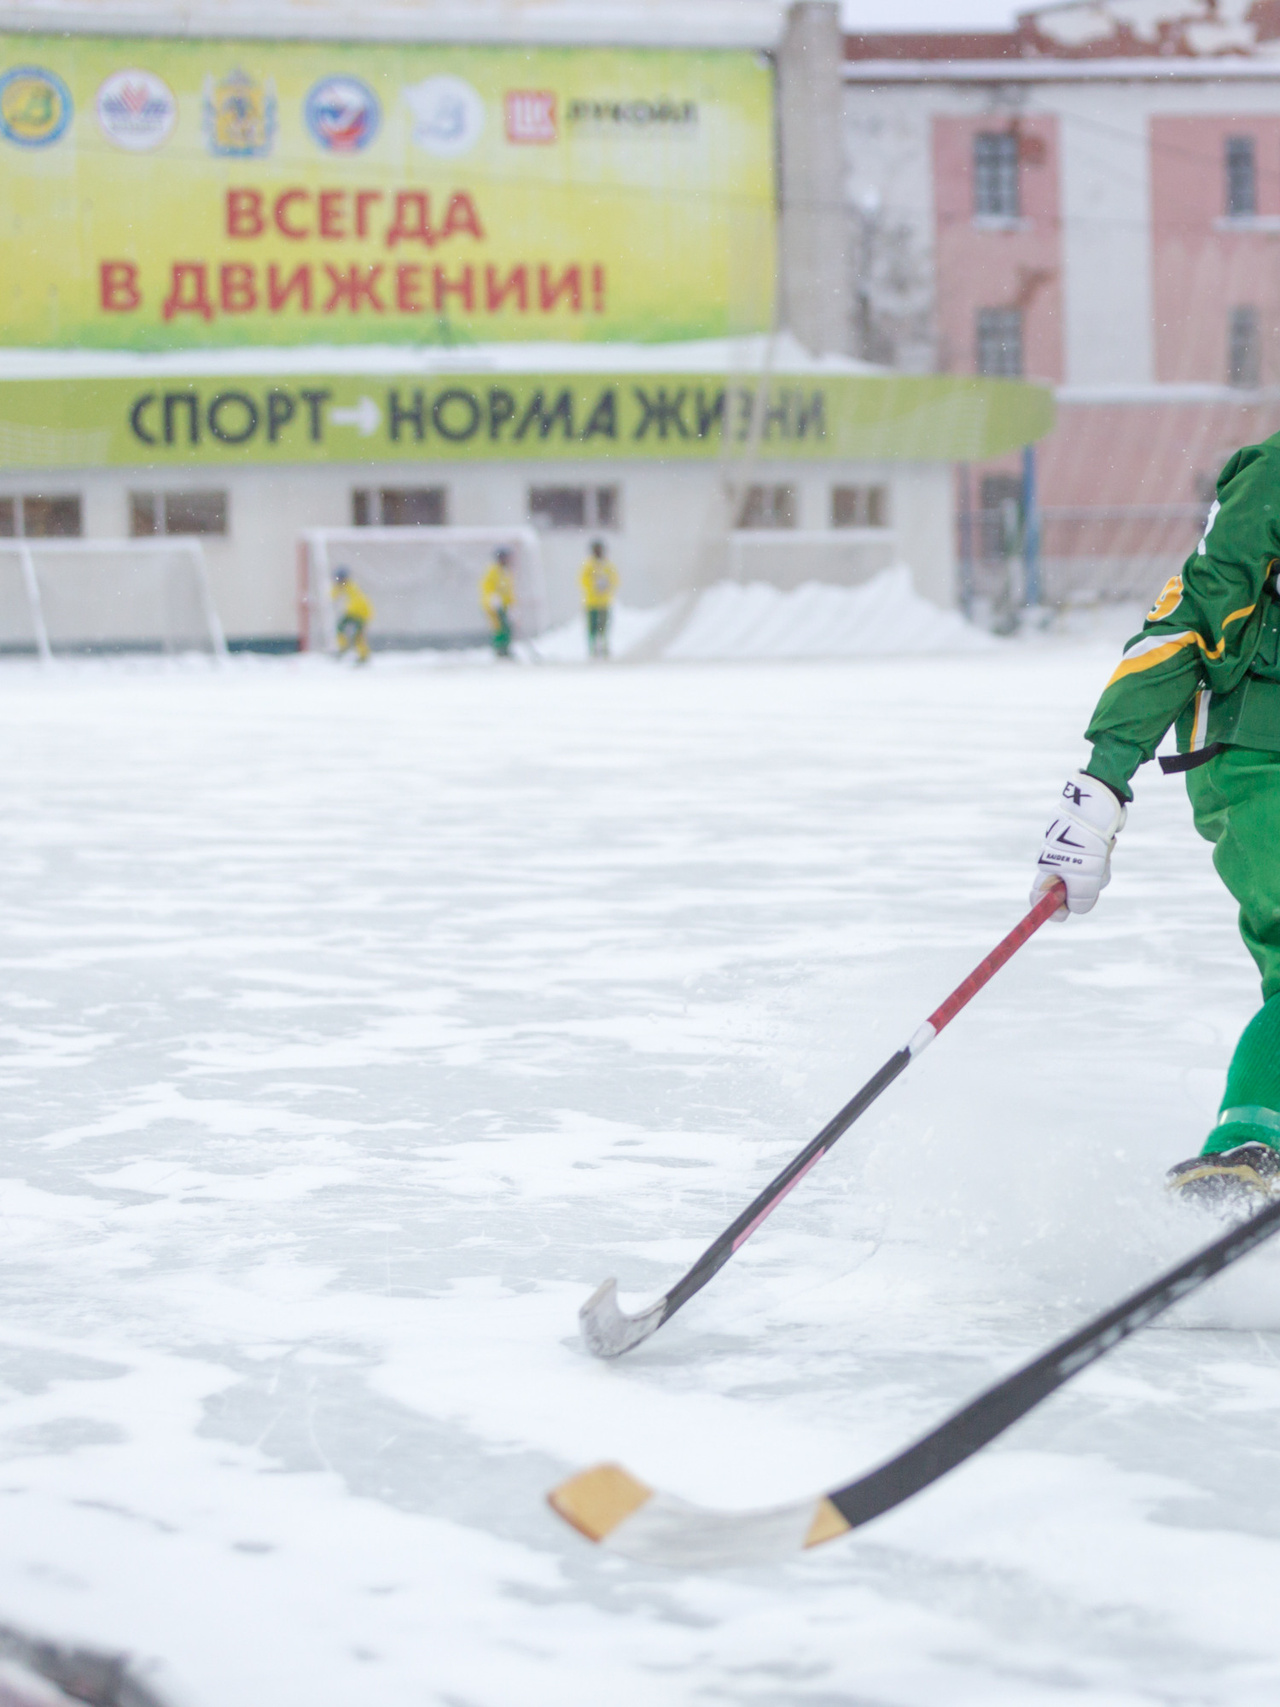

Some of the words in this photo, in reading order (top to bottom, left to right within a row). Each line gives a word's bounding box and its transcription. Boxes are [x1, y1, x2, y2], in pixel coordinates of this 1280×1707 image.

[225, 188, 486, 249] ВСЕГДА
[100, 261, 142, 313] В
[161, 260, 606, 323] ДВИЖЕНИИ!
[130, 389, 331, 445] СПОРТ
[388, 388, 616, 443] НОРМА
